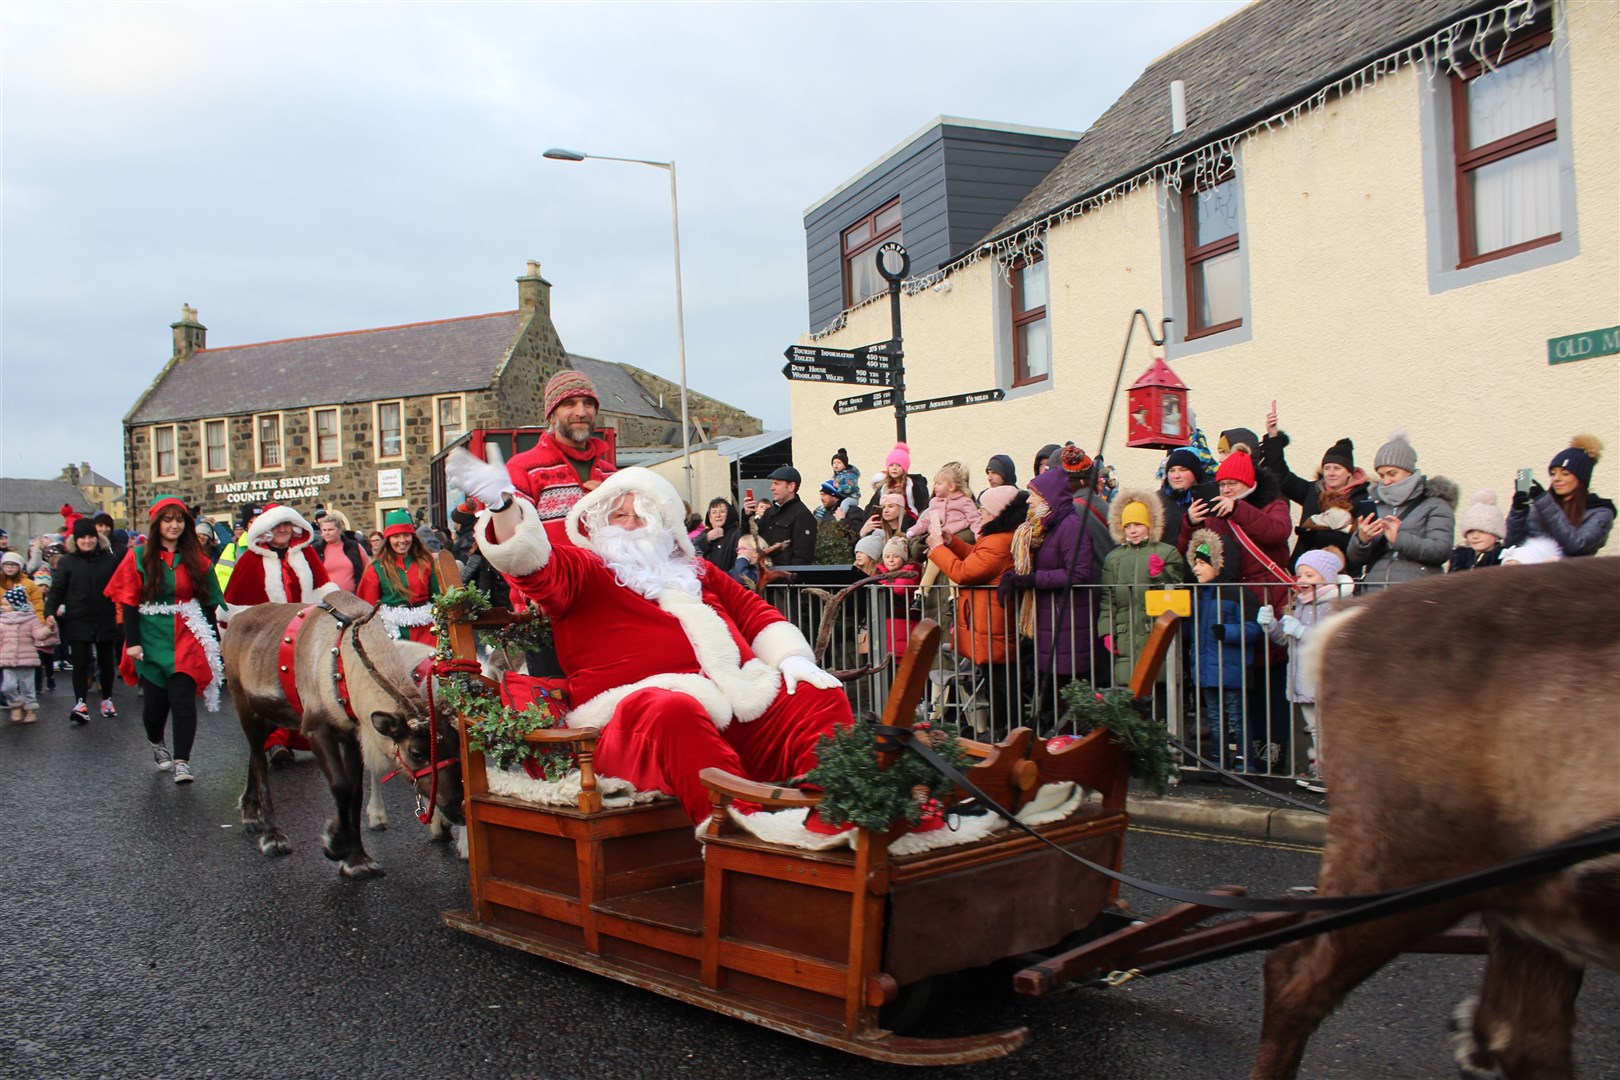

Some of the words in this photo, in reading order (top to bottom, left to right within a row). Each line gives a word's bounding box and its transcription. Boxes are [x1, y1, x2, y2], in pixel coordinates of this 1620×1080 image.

[793, 347, 816, 355] TOURIST
[821, 349, 854, 358] INFORMATION
[1556, 336, 1592, 358] OLD
[792, 372, 821, 380] WOODLAND
[809, 366, 826, 374] HOUSE
[215, 482, 249, 493] BANFF
[251, 480, 278, 490] TYRE
[280, 475, 331, 488] SERVICES
[227, 491, 268, 503] COUNTY
[273, 487, 319, 500] GARAGE
